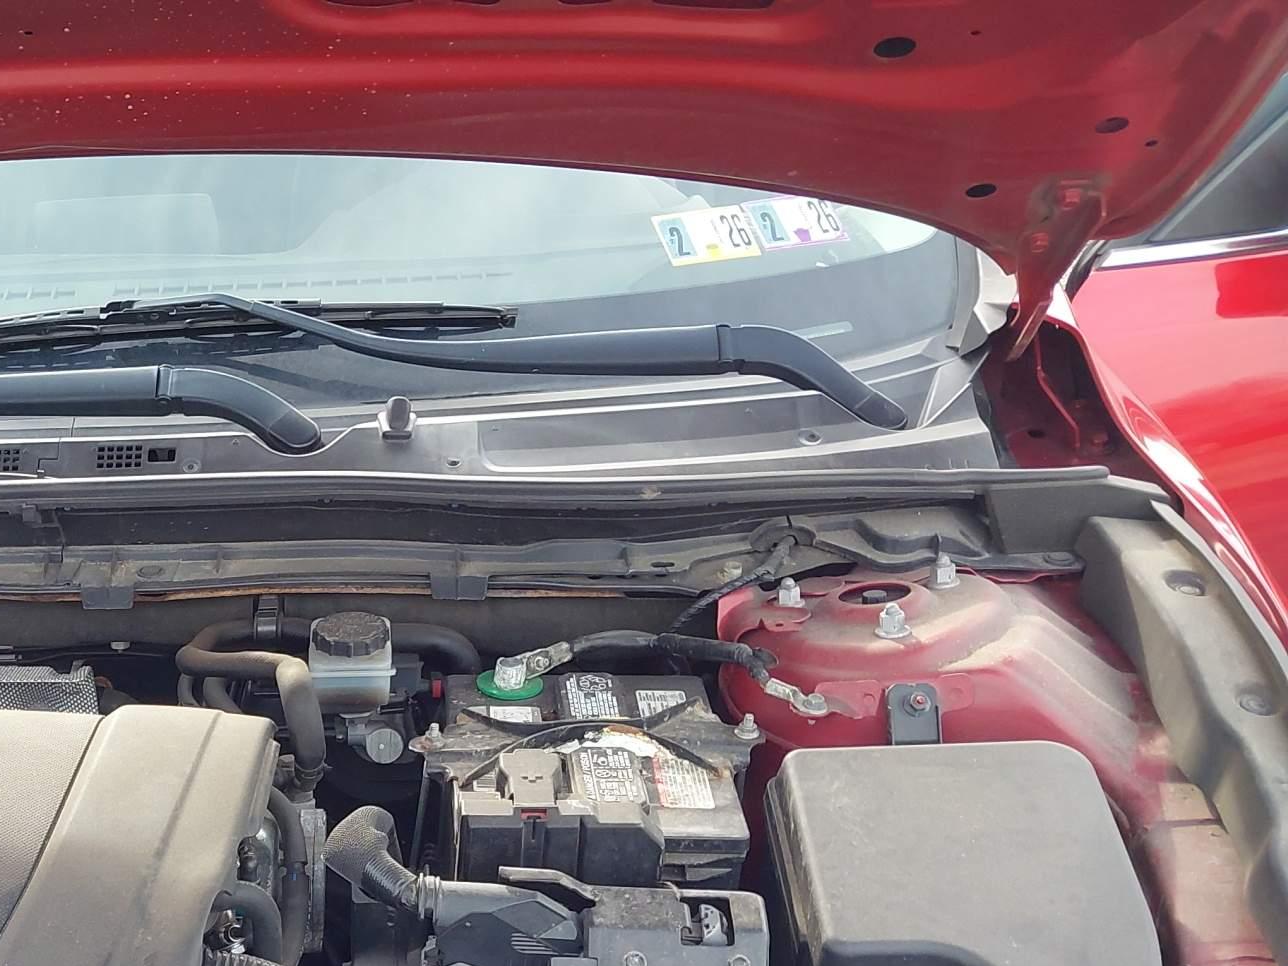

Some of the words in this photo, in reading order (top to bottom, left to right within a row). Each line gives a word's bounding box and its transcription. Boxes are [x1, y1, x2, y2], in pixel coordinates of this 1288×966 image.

[668, 226, 691, 257] 2
[719, 213, 752, 248] 26
[760, 212, 784, 242] 2
